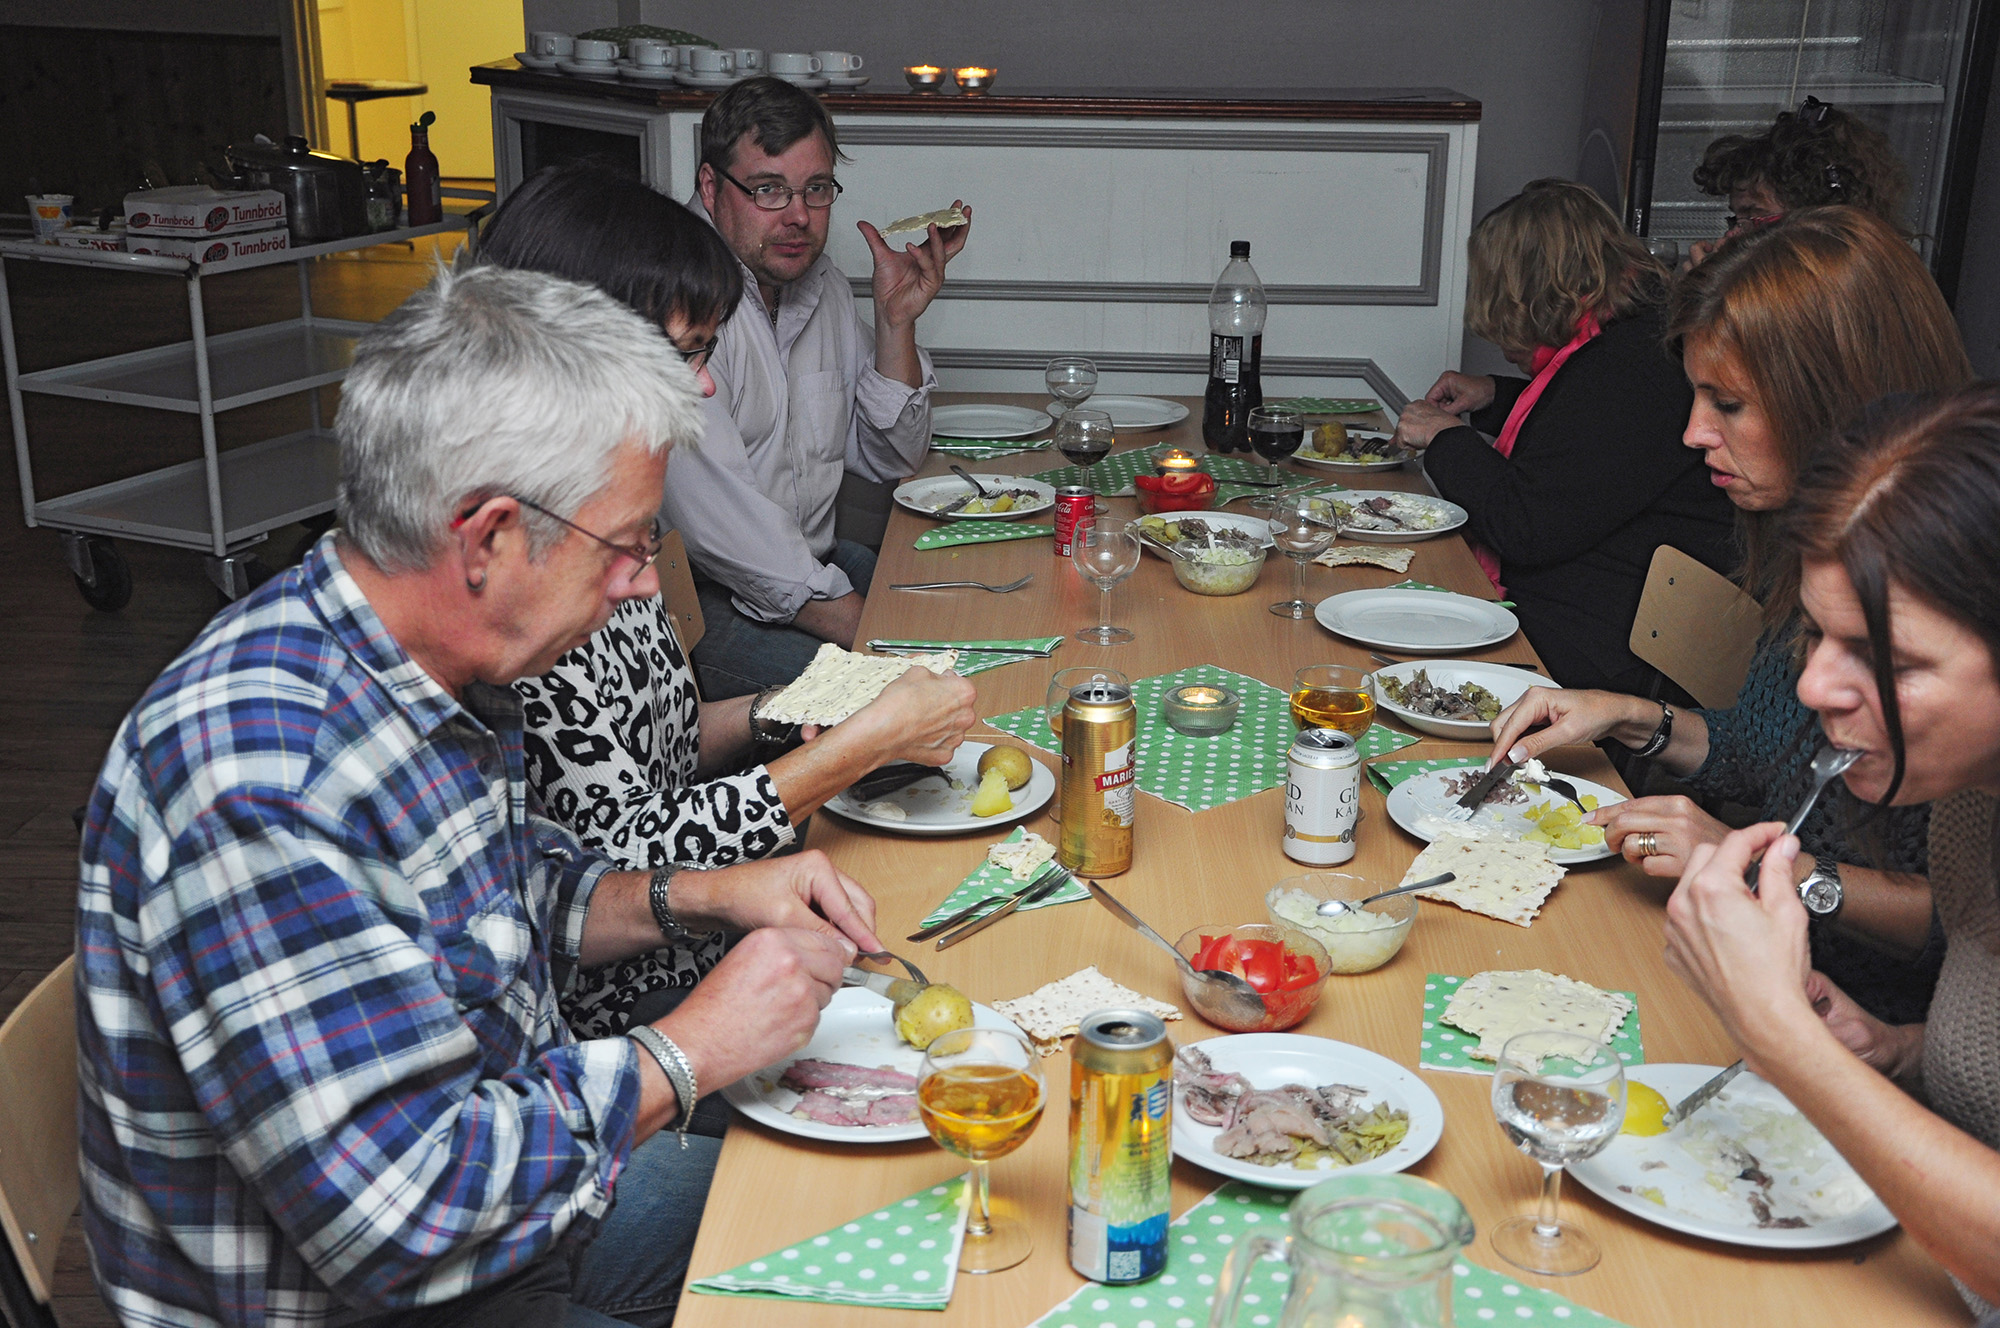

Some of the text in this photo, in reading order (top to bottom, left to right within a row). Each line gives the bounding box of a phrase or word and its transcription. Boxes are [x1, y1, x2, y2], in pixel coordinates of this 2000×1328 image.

[152, 213, 195, 226] Tunnbröd
[232, 201, 282, 221] Tunnbröd
[232, 235, 286, 256] Tunnbröd
[1340, 786, 1358, 803] GU
